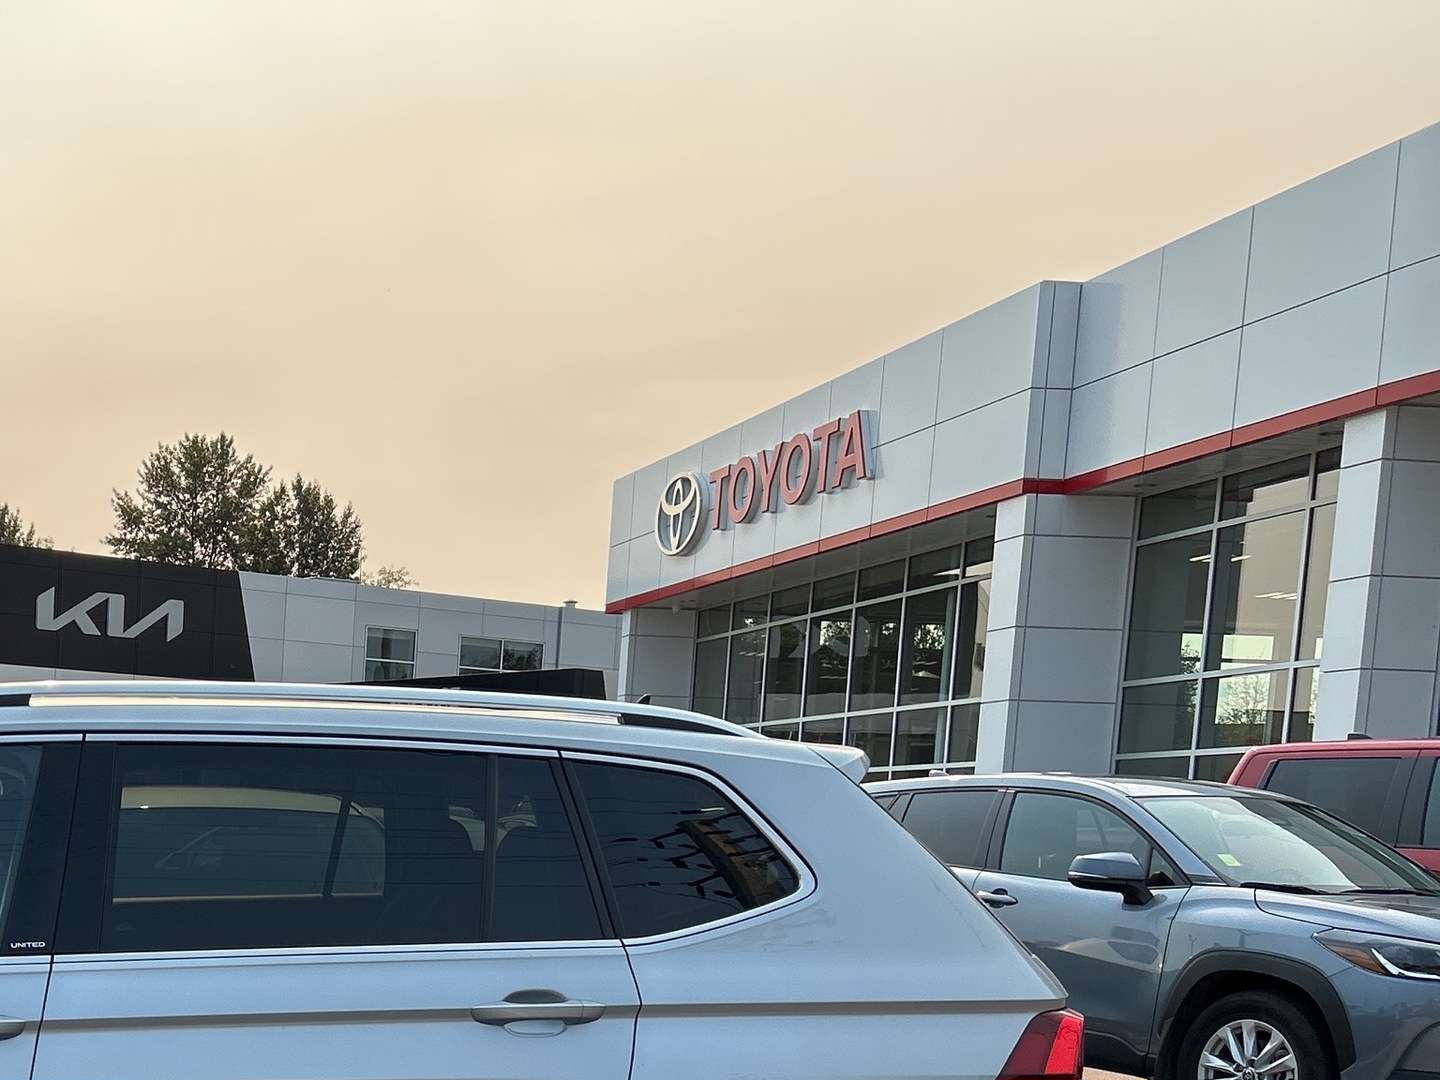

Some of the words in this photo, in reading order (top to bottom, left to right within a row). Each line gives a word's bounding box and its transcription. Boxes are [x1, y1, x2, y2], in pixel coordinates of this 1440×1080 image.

[709, 409, 870, 531] TOYOTA
[35, 586, 185, 642] KIA
[10, 941, 46, 949] UNITED
